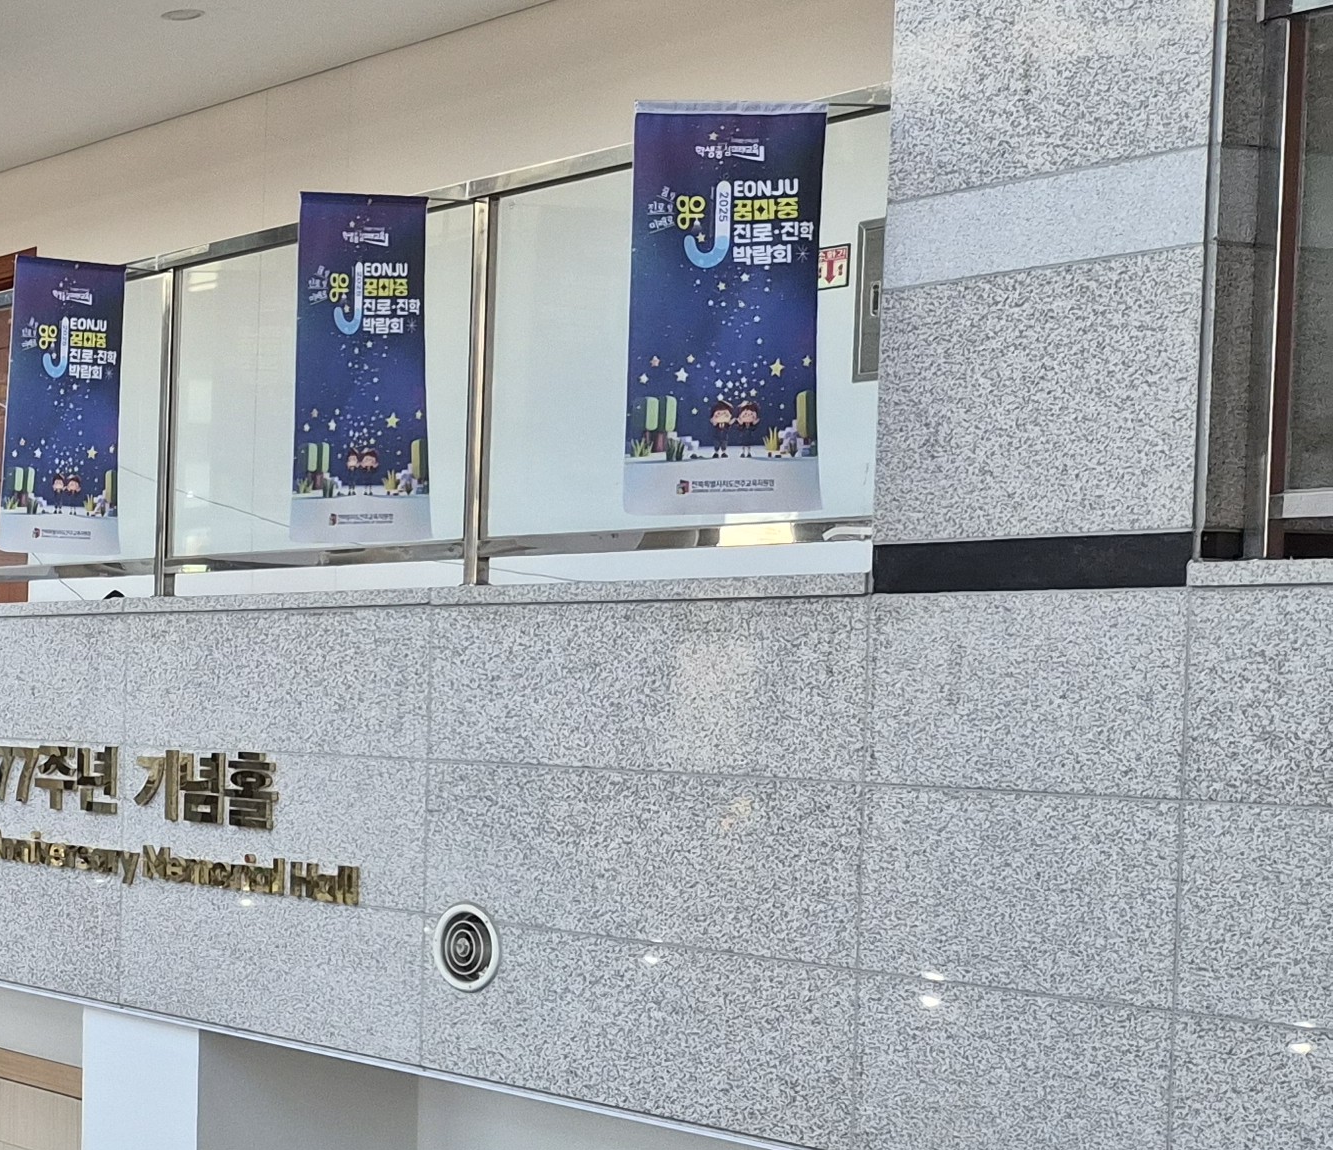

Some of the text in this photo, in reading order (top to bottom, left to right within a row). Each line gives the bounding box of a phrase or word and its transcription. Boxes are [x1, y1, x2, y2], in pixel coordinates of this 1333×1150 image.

[733, 178, 799, 198] EONJU
[718, 191, 729, 223] 2025
[733, 197, 799, 221] 꿈마중
[733, 221, 814, 243] 진로·진학
[733, 243, 793, 265] 박람회
[363, 278, 408, 297] 꿈마중
[363, 298, 420, 316] 진로·진학
[362, 317, 404, 335] 박람회
[69, 332, 108, 349] 꿈마중
[68, 364, 102, 380] 박람회
[132, 749, 280, 831] 기념홀
[141, 844, 286, 896] Memorial
[289, 860, 361, 906] Hall
